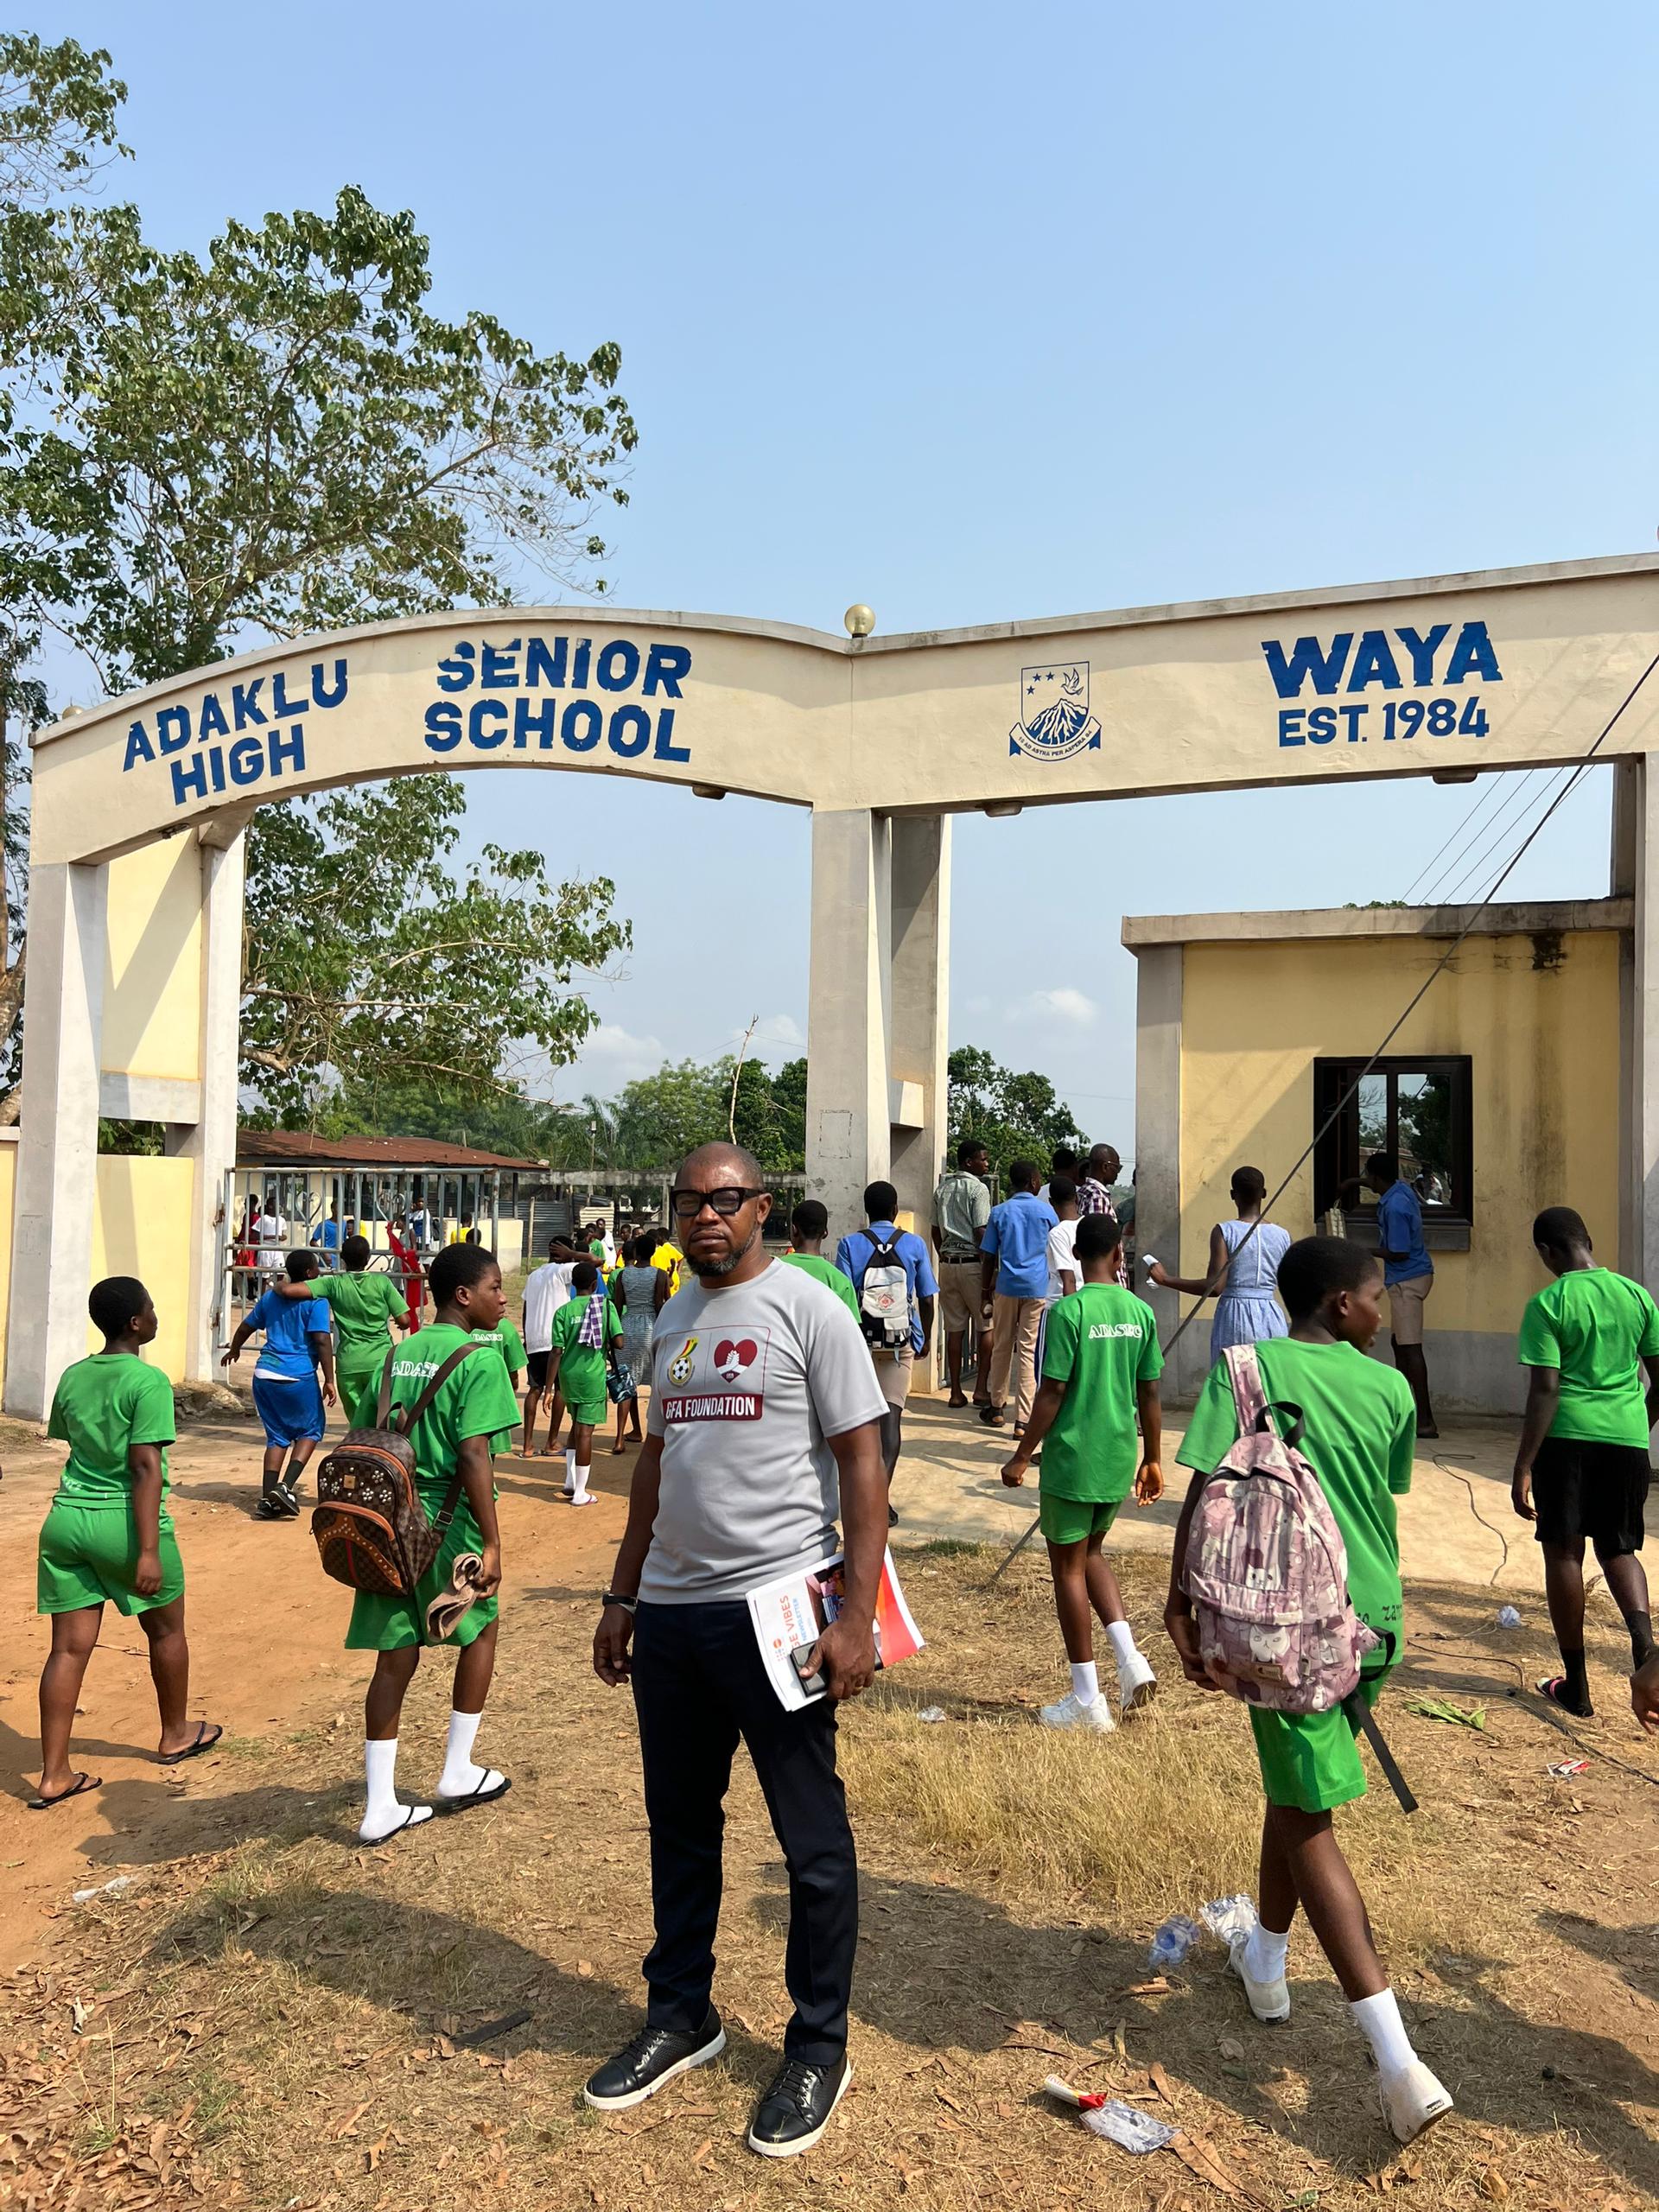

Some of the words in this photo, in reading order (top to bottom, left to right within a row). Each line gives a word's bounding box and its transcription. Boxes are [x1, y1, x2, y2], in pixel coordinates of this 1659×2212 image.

[1261, 621, 1503, 699] WAYA
[124, 658, 348, 772] ADAKLU
[436, 636, 692, 699] SENIOR
[1278, 704, 1369, 748] EST.
[1382, 696, 1491, 741] 1984
[170, 723, 306, 805] HIGH
[424, 696, 691, 763] SCHOOL
[1032, 747, 1050, 756] ASTRA
[1065, 737, 1086, 753] ASPERA
[1088, 1323, 1143, 1339] ADASEC
[391, 1360, 441, 1380] ADASE
[665, 1398, 683, 1420] GFA
[684, 1395, 755, 1418] FOUNDATION
[779, 1595, 795, 1632] VIBES
[792, 1598, 807, 1641] NEWSLETTER
